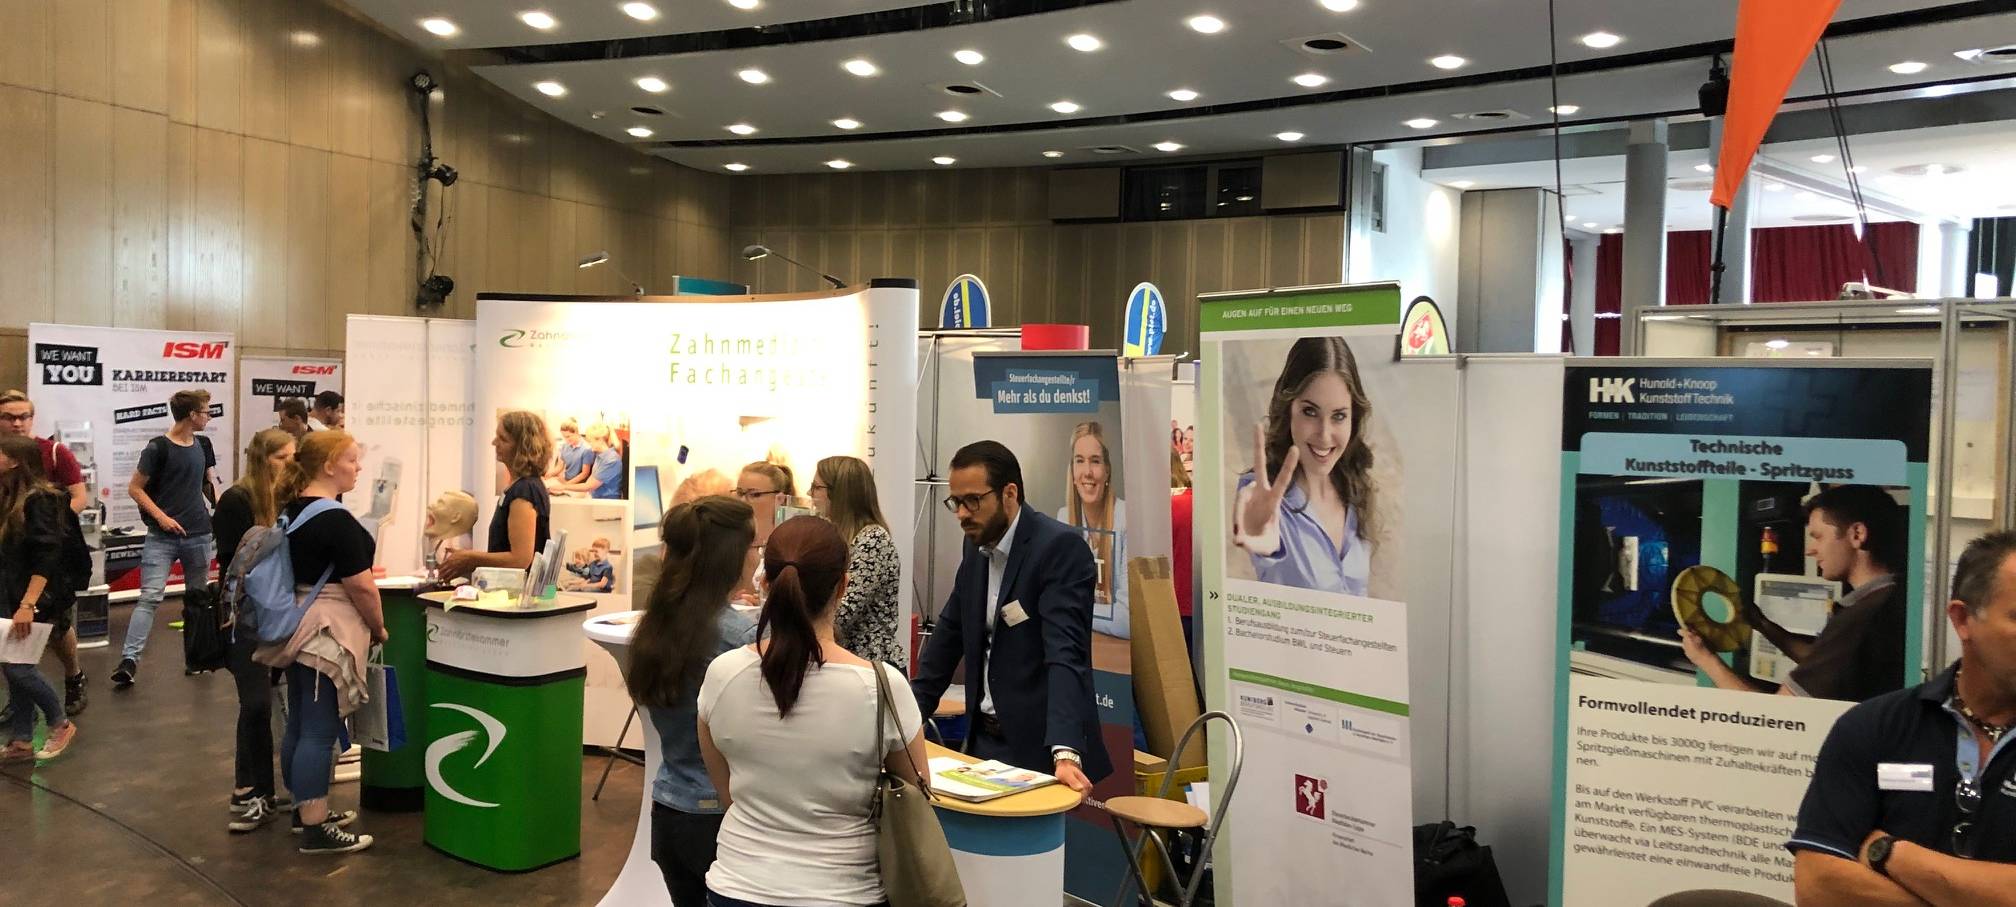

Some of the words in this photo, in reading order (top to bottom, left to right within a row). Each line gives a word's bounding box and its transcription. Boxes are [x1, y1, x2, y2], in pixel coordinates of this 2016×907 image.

[1222, 310, 1247, 319] AUGEN
[1249, 309, 1263, 317] AUF
[1265, 305, 1280, 317] FÜR
[1281, 306, 1305, 316] EINEN
[1306, 305, 1333, 315] NEUEN
[1335, 303, 1353, 313] WEG
[42, 350, 61, 360] WE
[63, 351, 93, 361] WANT
[163, 341, 224, 359] ISM
[46, 364, 96, 383] YOU
[112, 370, 228, 383] KARRIERESTART
[292, 365, 334, 375] ISM
[256, 384, 273, 393] WE
[276, 384, 307, 394] WANT
[997, 389, 1021, 404] Mehr
[1023, 389, 1037, 404] als
[1039, 389, 1051, 404] du
[1053, 389, 1091, 404] denkst!
[1588, 411, 1620, 420] FORMEN
[1628, 412, 1668, 421] TRADITION
[1689, 438, 1783, 456] Technische
[1625, 457, 1747, 476] Kunststoffteile
[1760, 461, 1855, 482] Spritzguss
[1310, 642, 1323, 651] und
[1325, 643, 1353, 656] Steuern
[1579, 695, 1697, 720] Formvollendet
[1700, 710, 1806, 731] produzieren
[1577, 726, 1598, 738] Ihre
[1600, 729, 1649, 744] Produkte
[1652, 735, 1668, 746] bis
[1671, 737, 1706, 752] 3000g
[1709, 741, 1754, 756] fertigen
[1757, 748, 1775, 758] wir
[1778, 750, 1798, 761] auf
[1576, 740, 1691, 763] Spritzgießmaschinen
[1693, 756, 1713, 766] mit
[1715, 756, 1803, 777] Zuhaltekräften
[1576, 757, 1599, 767] nen.
[1575, 783, 1591, 795] Bis
[1592, 787, 1611, 797] auf
[1612, 790, 1633, 801] den
[1635, 792, 1689, 808] Werkstoff
[1691, 798, 1714, 811] PVC
[1716, 805, 1784, 821] verarbeiten
[1574, 800, 1592, 809] am
[1593, 801, 1625, 815] Markt
[1627, 807, 1697, 824] verfügbaren
[1574, 813, 1635, 831] Kunststoffe.
[1639, 822, 1657, 834] Ein
[1573, 828, 1632, 845] überwacht
[1634, 838, 1650, 849] via
[1652, 839, 1747, 862] Leitstandtechnik
[1750, 852, 1772, 865] alle
[1573, 843, 1647, 863] gewährleistet
[1648, 854, 1673, 866] eine
[1675, 858, 1751, 877] einwandfreie
